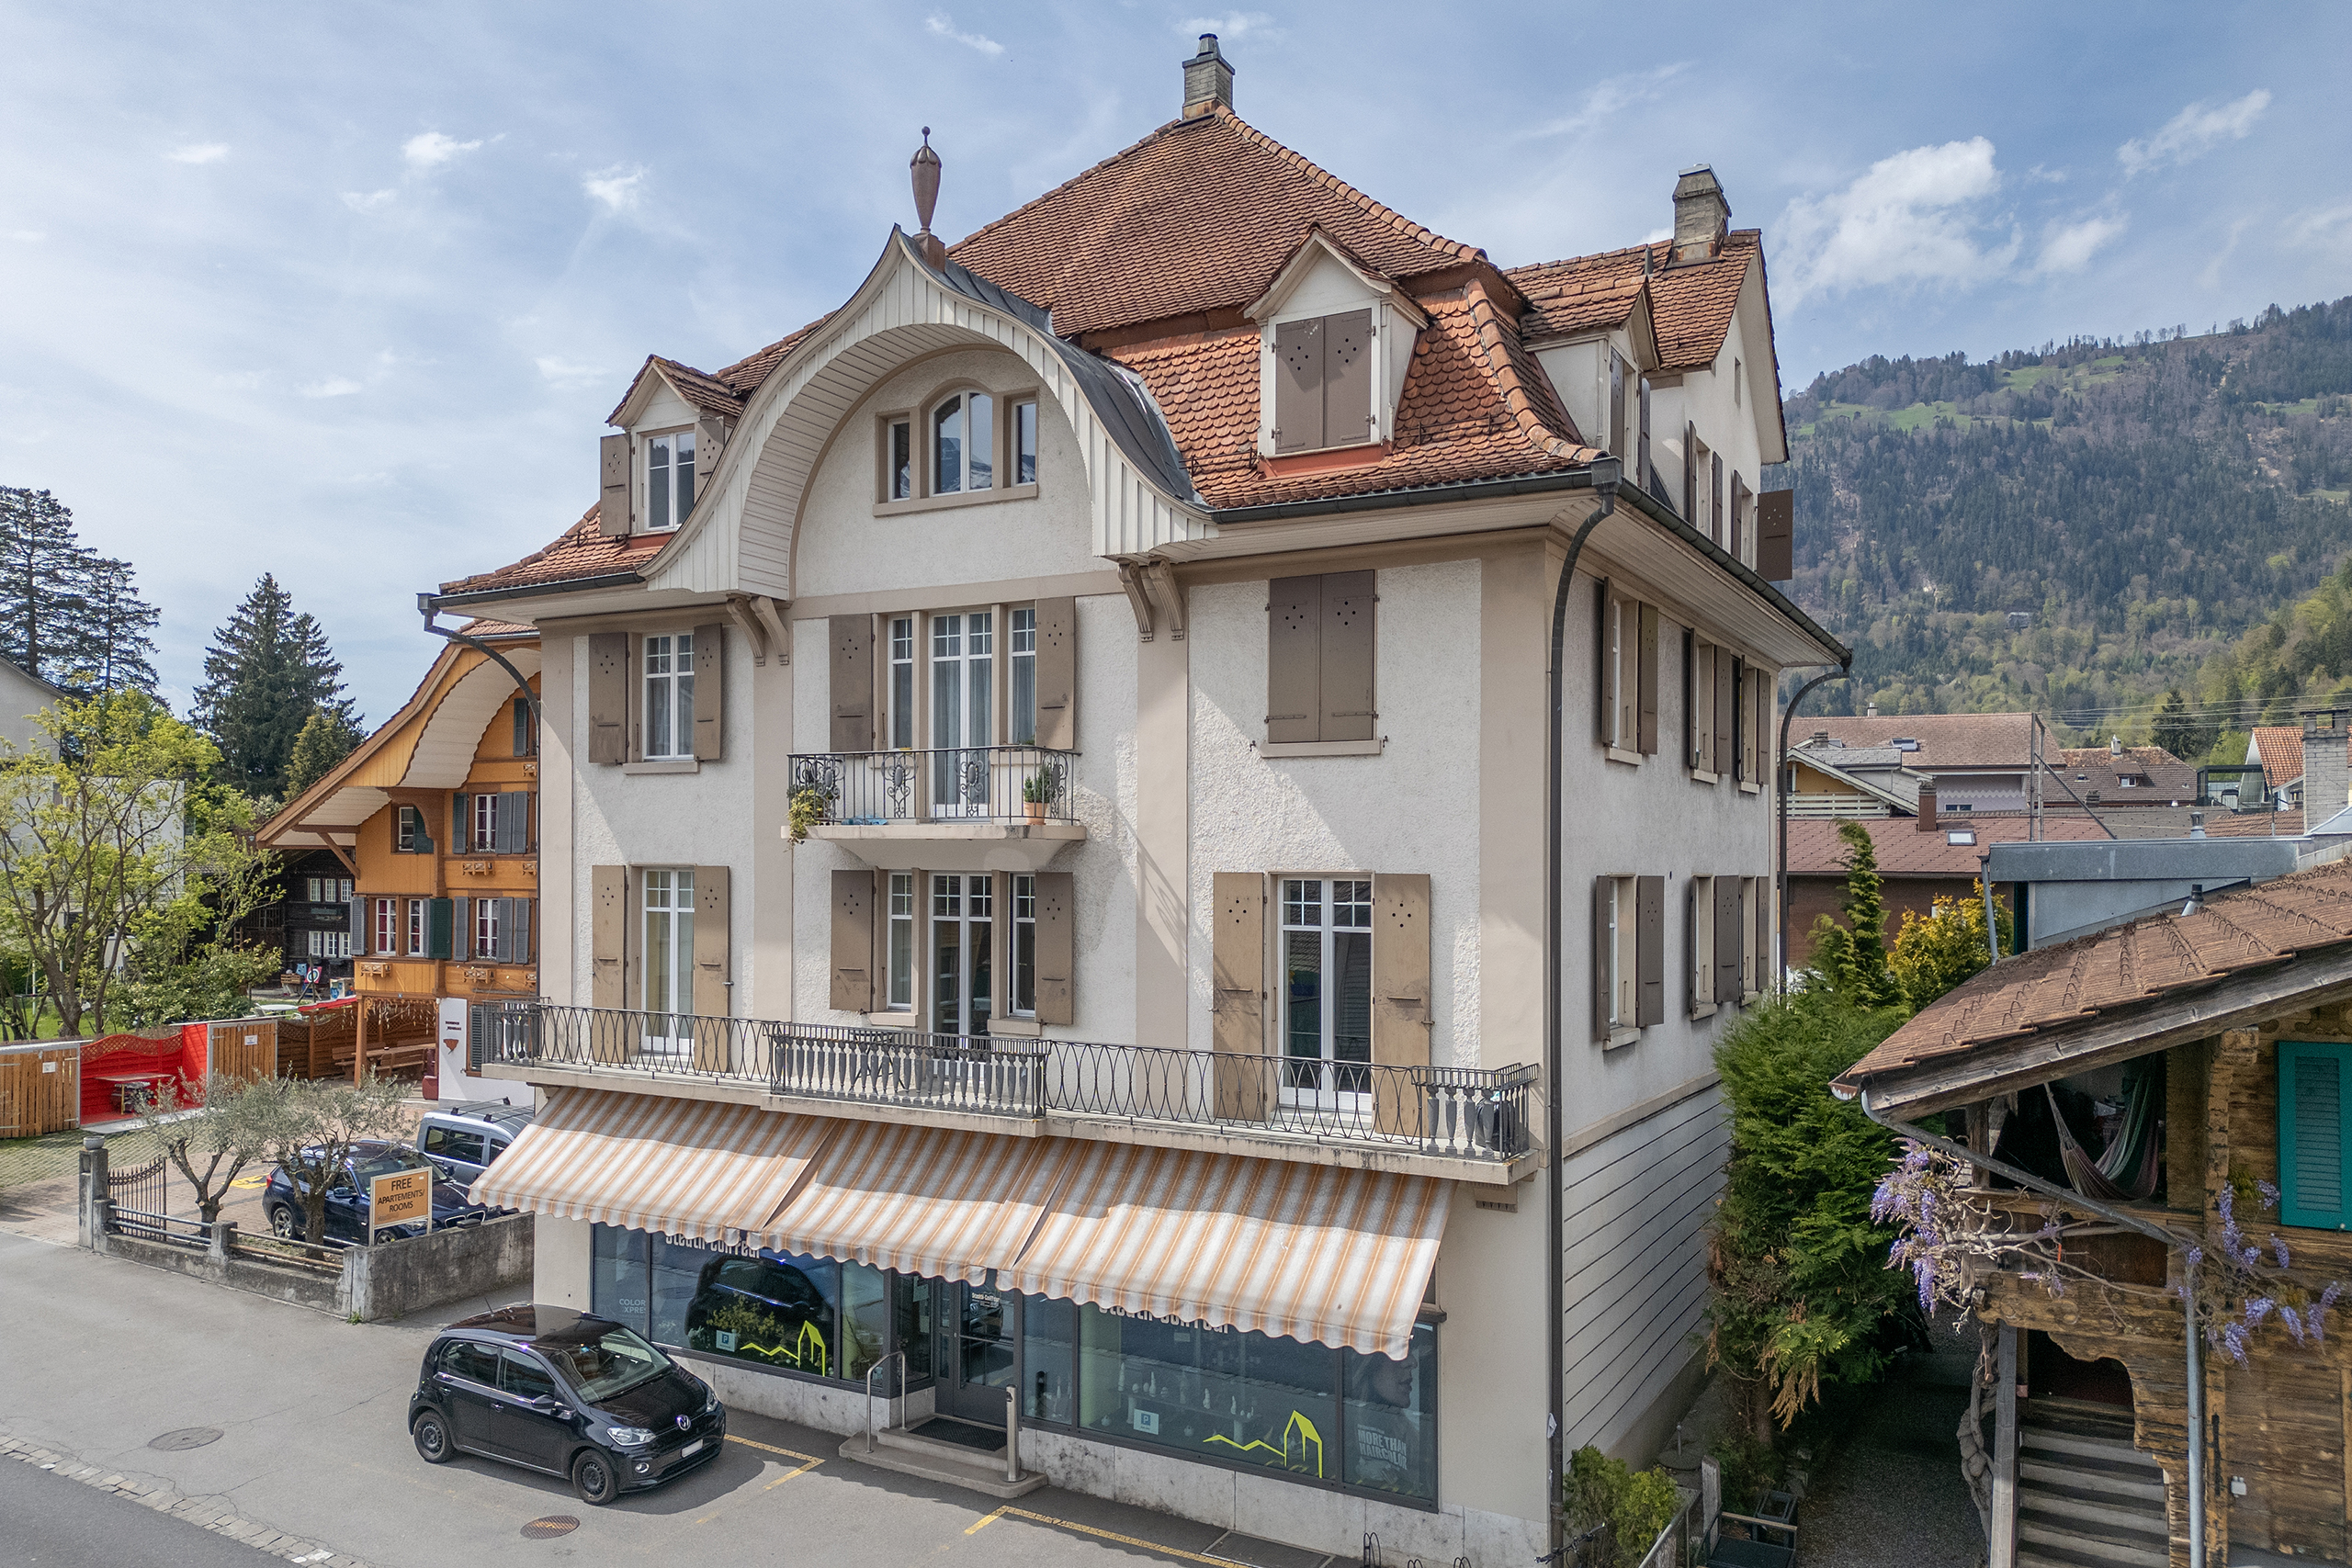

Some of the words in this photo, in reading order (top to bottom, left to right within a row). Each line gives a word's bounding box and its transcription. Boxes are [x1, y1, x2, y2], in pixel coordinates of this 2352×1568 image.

[391, 1178, 412, 1191] FREE
[378, 1189, 424, 1205] APARTEMENTS/
[390, 1201, 413, 1213] ROOMS
[618, 1298, 646, 1306] COLOR
[1358, 1429, 1384, 1448] MORE
[1384, 1437, 1407, 1456] THAN
[1359, 1442, 1408, 1470] HAIRCOLOR
